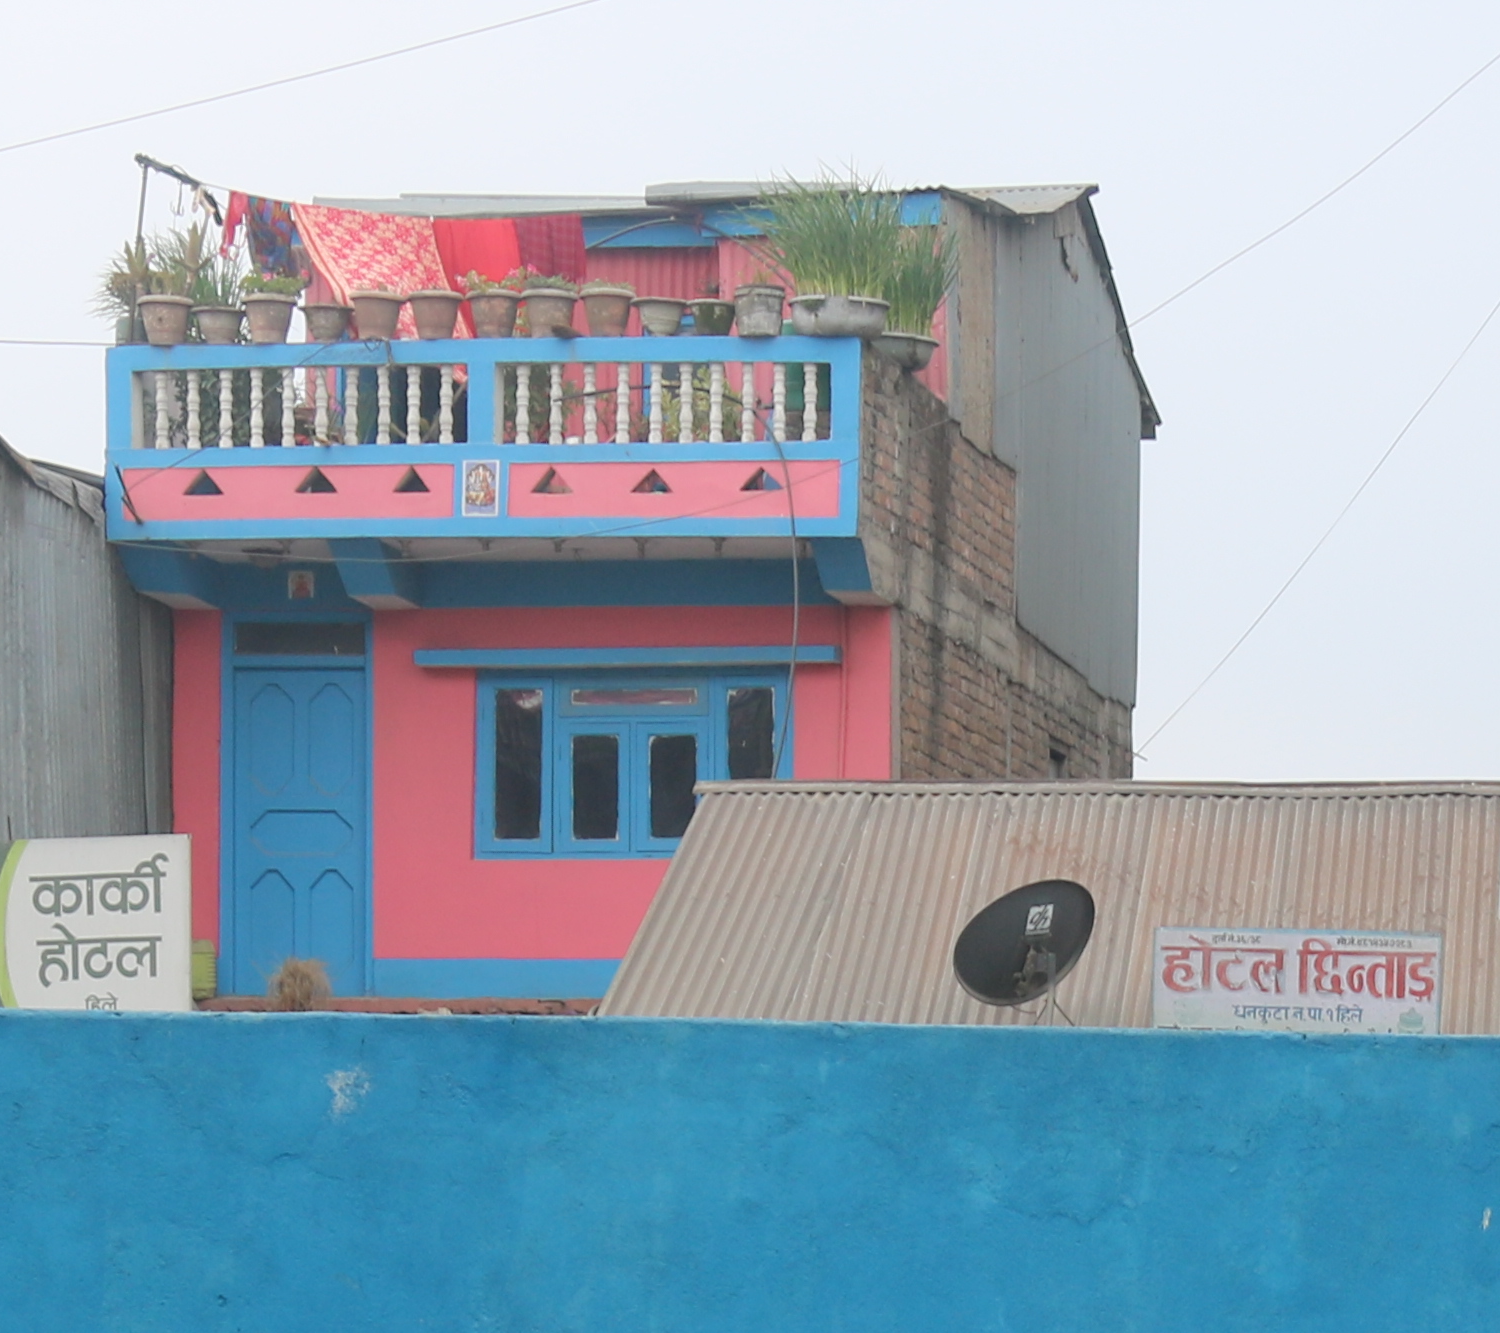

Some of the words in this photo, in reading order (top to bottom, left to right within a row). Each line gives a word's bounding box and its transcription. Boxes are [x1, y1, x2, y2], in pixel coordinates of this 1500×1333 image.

[29, 852, 169, 917] कार्की
[36, 923, 162, 987] होटल
[1160, 934, 1287, 994] होटल
